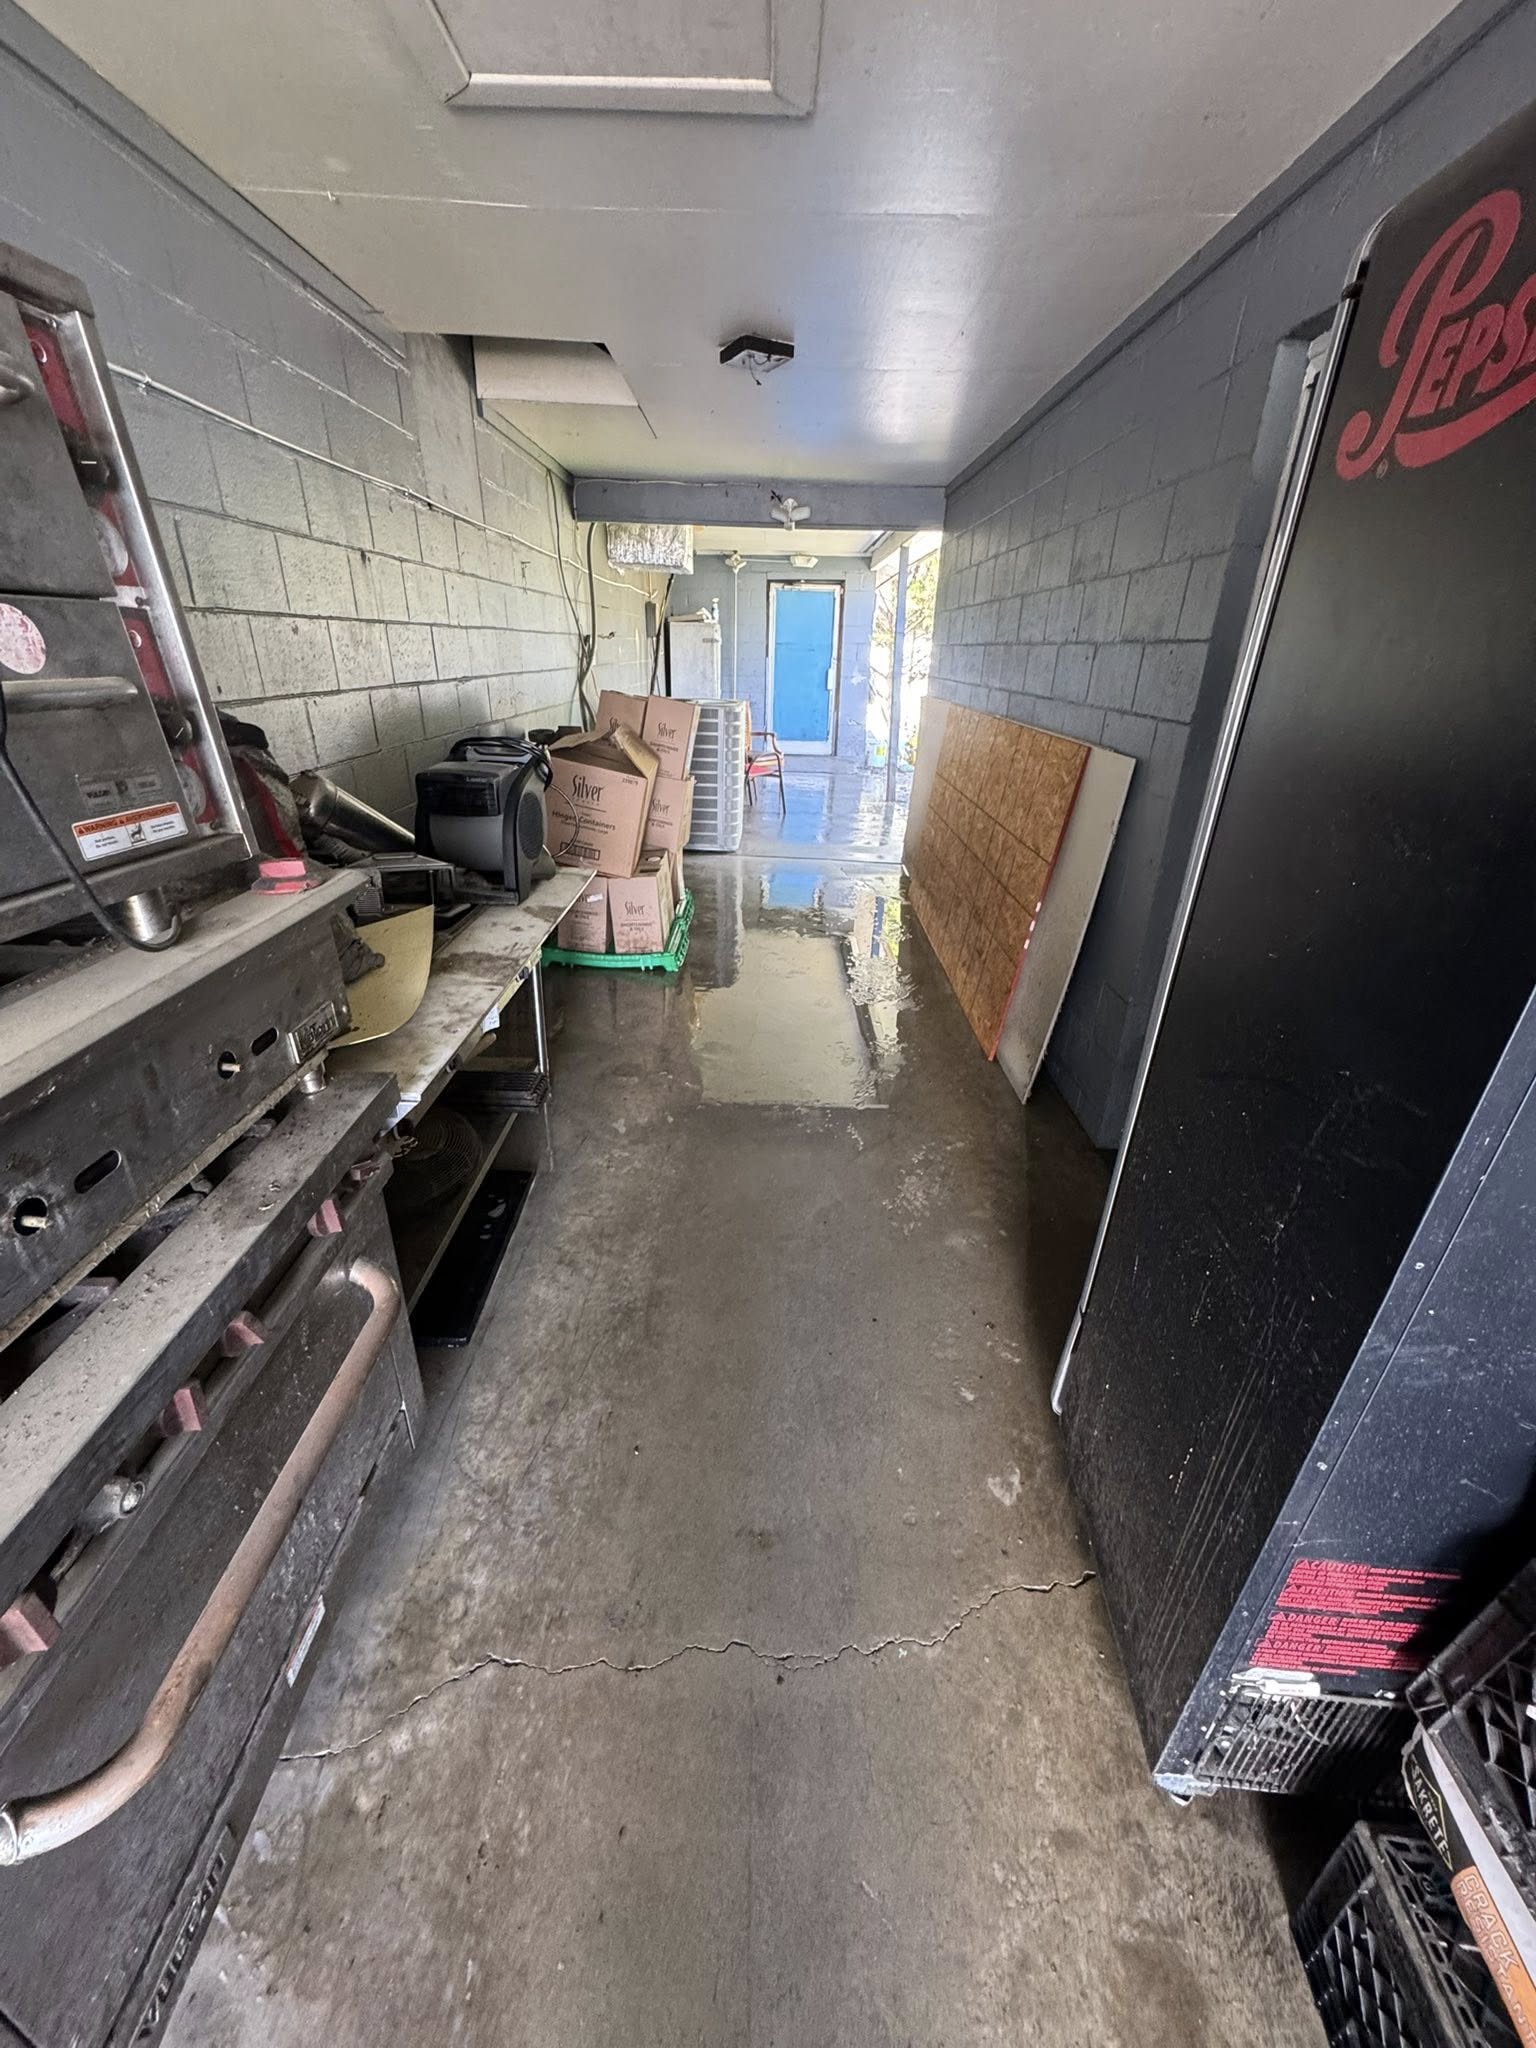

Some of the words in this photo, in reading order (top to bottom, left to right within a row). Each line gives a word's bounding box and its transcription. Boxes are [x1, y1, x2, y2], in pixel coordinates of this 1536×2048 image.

[1336, 189, 1536, 480] PEPS
[658, 722, 677, 738] Silver
[572, 774, 606, 802] Silver
[84, 819, 118, 833] WARNING
[579, 815, 616, 831] Containers
[625, 901, 645, 916] Silver
[1310, 1560, 1368, 1574] CAUTION
[1297, 1585, 1354, 1598] ATTENTION
[1287, 1612, 1339, 1626] DANGER
[1273, 1640, 1322, 1653] DANGER
[1411, 1765, 1449, 1853] SAKRETE
[1464, 1873, 1520, 1972] CRACK
